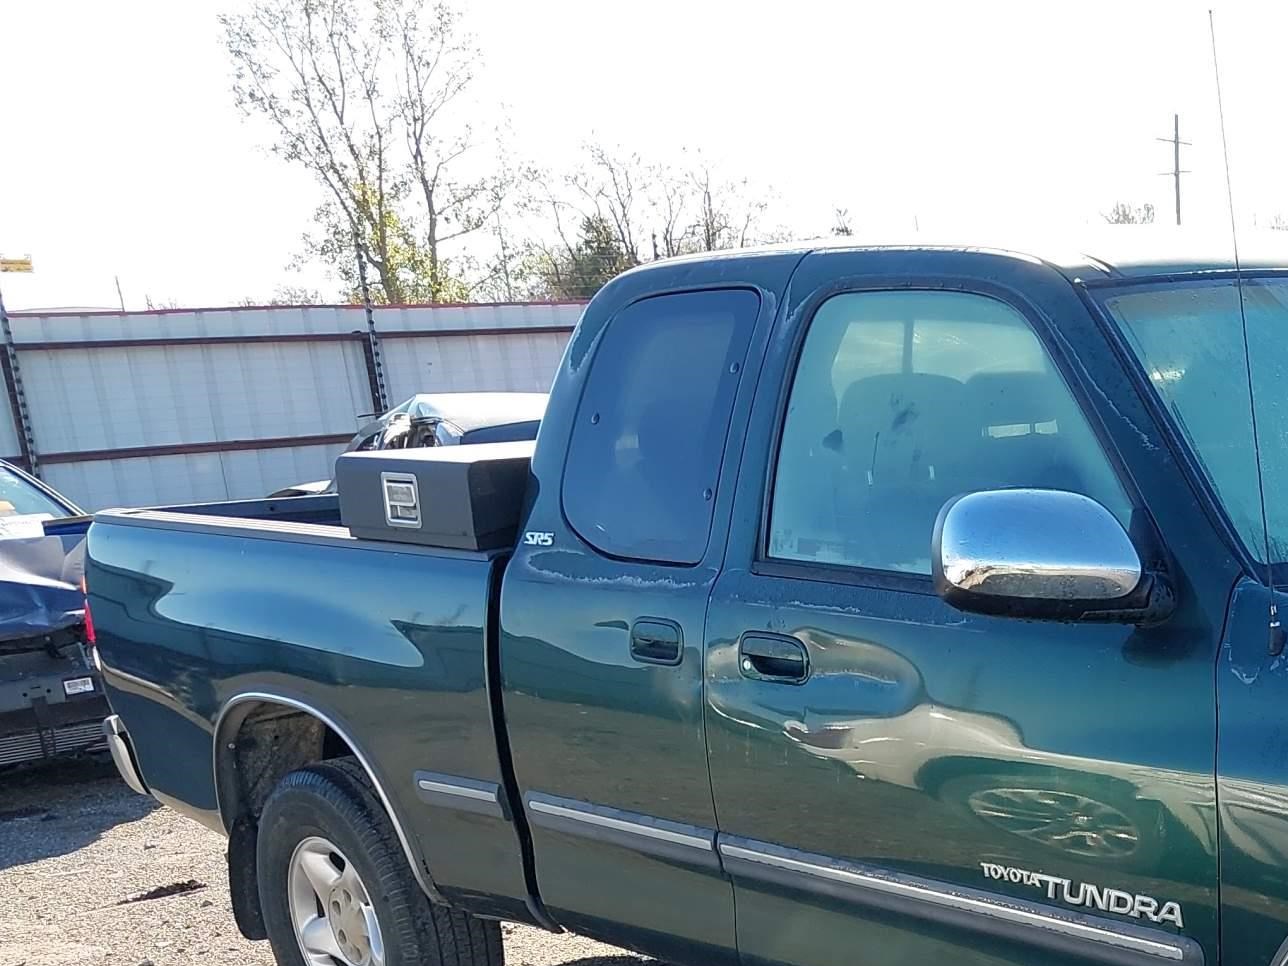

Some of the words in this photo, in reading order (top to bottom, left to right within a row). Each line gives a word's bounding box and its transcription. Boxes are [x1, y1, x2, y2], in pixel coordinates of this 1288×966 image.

[523, 531, 555, 546] SR5
[979, 861, 1042, 888] TOYOTA
[1038, 874, 1184, 929] TUNDRA
